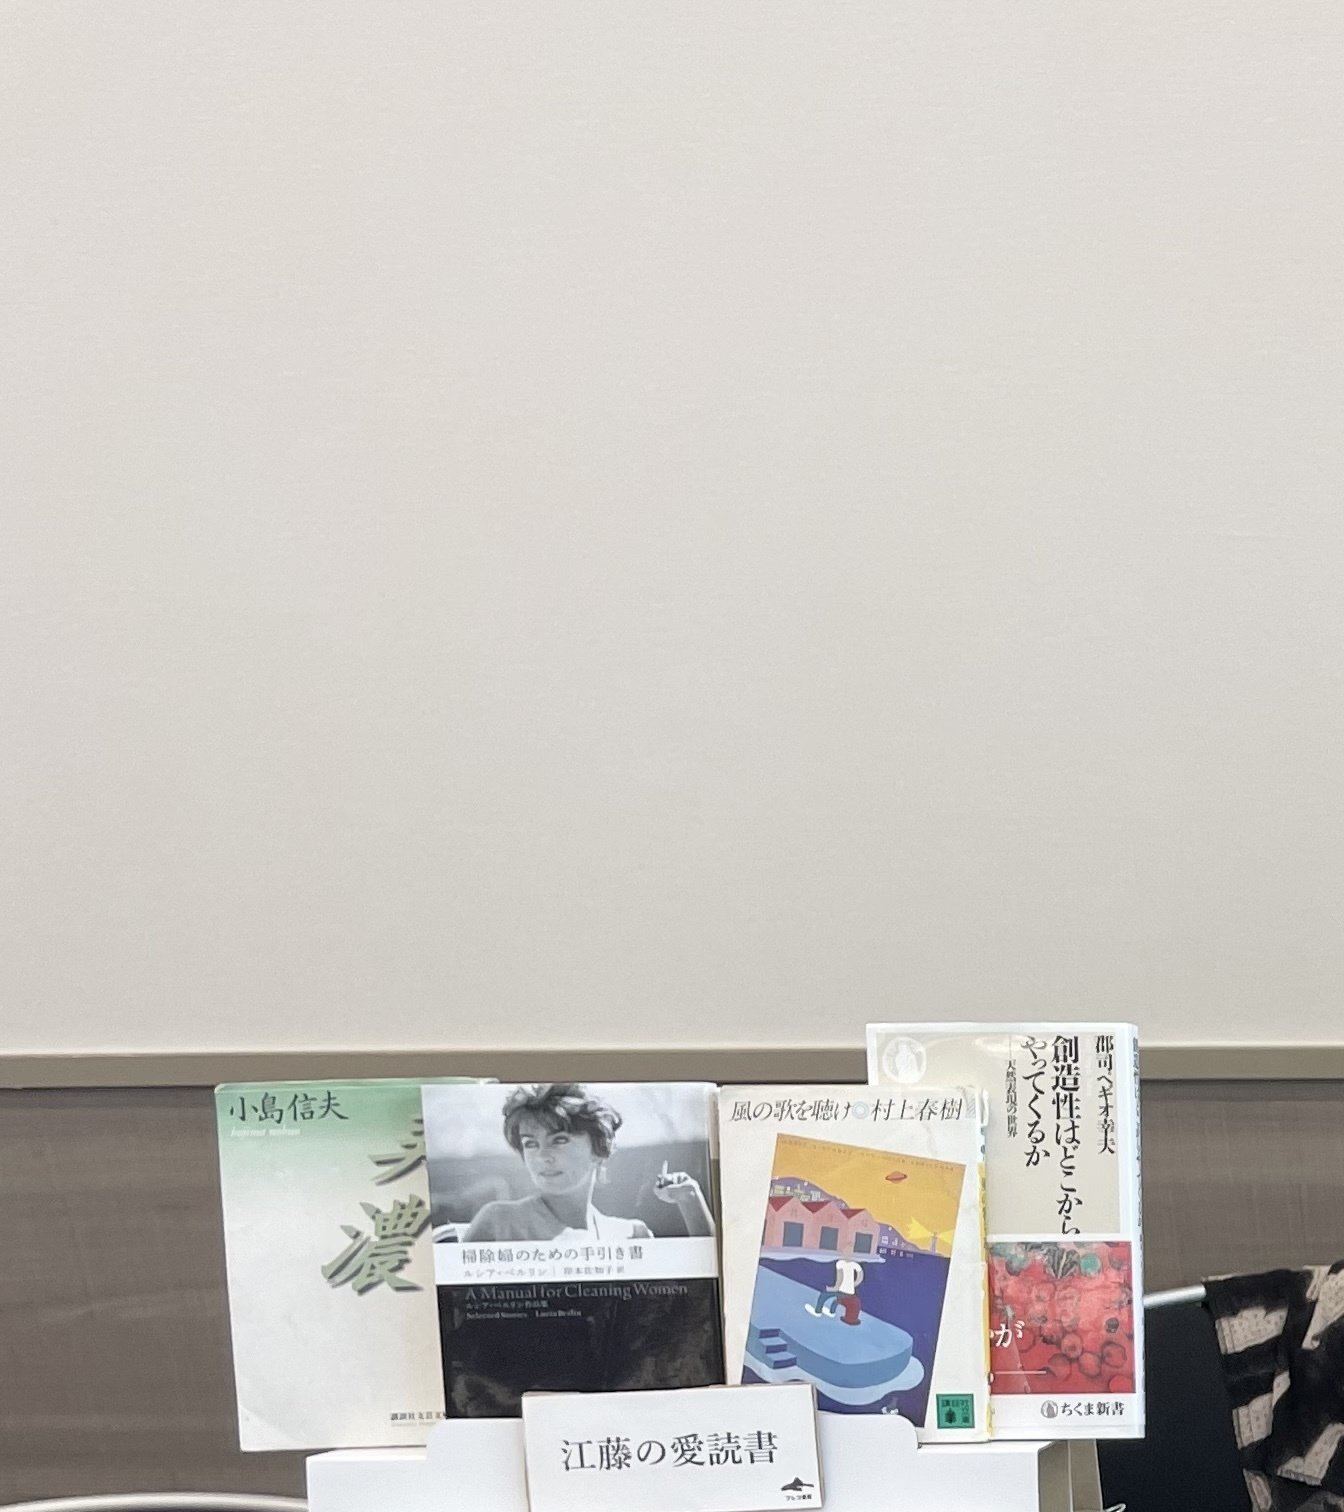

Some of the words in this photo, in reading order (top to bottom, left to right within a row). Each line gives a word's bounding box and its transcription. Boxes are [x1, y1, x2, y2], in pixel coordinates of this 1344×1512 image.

[230, 1090, 349, 1124] 小島信夫
[731, 1099, 850, 1122] 風の歌を聴け
[870, 1098, 963, 1122] 村上春樹
[1021, 1036, 1050, 1167] やってくるか
[1051, 1035, 1082, 1235] 創造性はどこから
[481, 1284, 537, 1300] Manual
[564, 1282, 632, 1301] Cleaning
[634, 1281, 688, 1296] Women
[1060, 1401, 1125, 1416] ちくま新書
[561, 1430, 778, 1471] 江藤の愛読書
